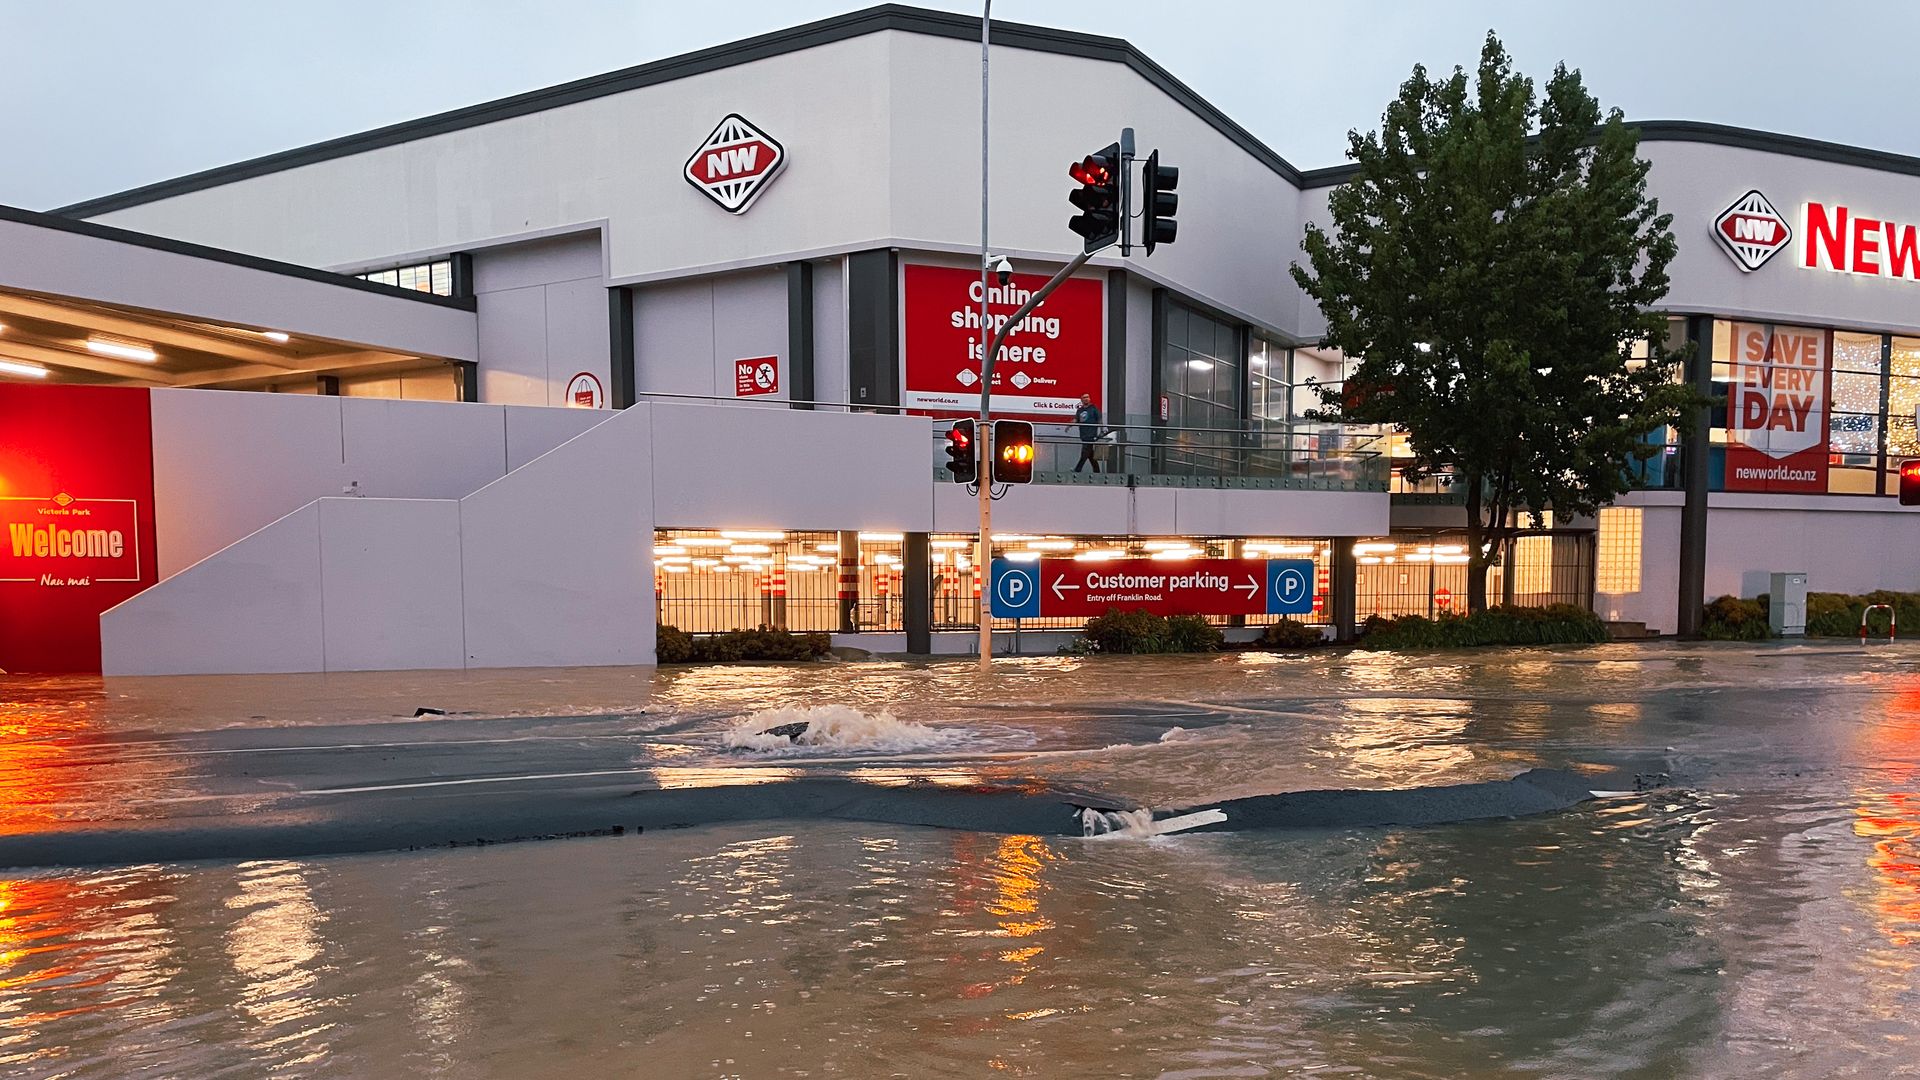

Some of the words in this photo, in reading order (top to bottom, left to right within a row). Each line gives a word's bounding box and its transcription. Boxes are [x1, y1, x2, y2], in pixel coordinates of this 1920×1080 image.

[707, 145, 758, 179] NW
[1735, 217, 1777, 242] NW
[1799, 201, 1920, 281] NEW
[951, 305, 1060, 339] shopping
[968, 337, 984, 361] is
[1745, 331, 1818, 366] SAVE
[739, 364, 752, 375] No
[1744, 366, 1816, 391] EVERY
[1033, 377, 1057, 386] Delivery
[1054, 402, 1074, 410] Collect
[1743, 391, 1815, 432] DAY
[1736, 465, 1817, 481] newworld.co.nz
[38, 508, 70, 516] Victoria
[72, 508, 91, 516] Park
[9, 523, 123, 557] Welcome
[40, 573, 65, 586] Nau
[67, 576, 91, 586] mai
[1009, 578, 1024, 599] P
[1086, 572, 1166, 589] Customer
[1169, 571, 1229, 592] parking
[1285, 577, 1298, 596] P
[1087, 594, 1105, 602] Entry
[1106, 594, 1117, 602] off
[1117, 594, 1144, 602] Franklin
[1144, 594, 1163, 602] Road.
